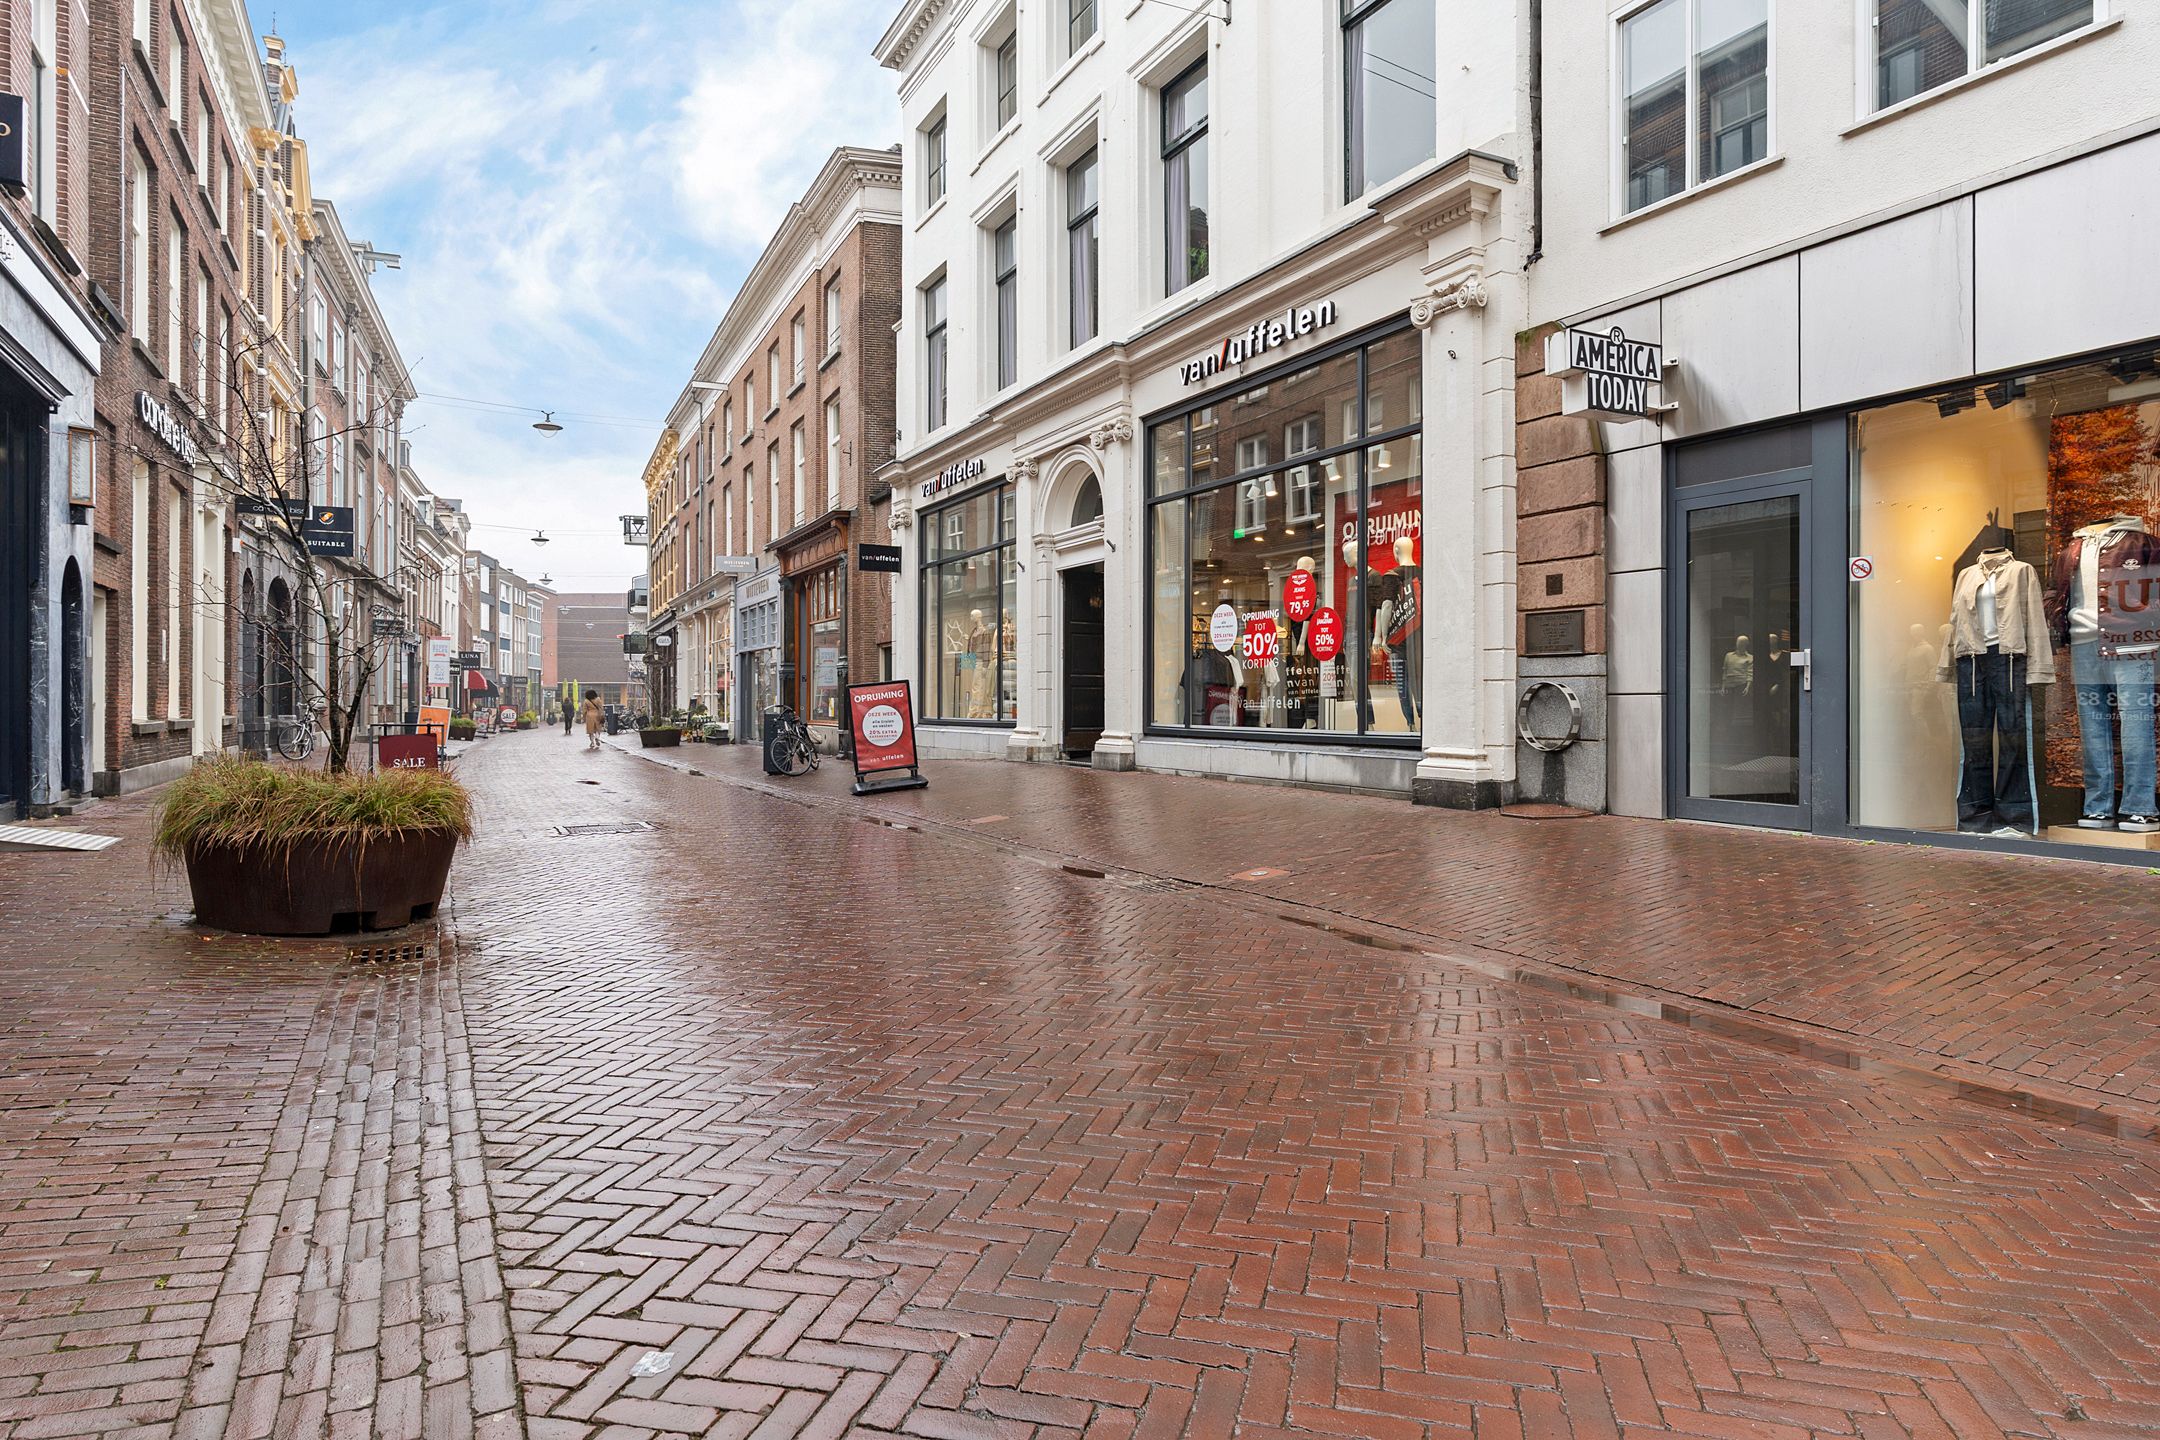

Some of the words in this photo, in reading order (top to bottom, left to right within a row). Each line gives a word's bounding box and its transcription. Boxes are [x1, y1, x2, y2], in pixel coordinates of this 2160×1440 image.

[1576, 336, 1658, 378] AMERICA
[1589, 373, 1645, 412] TODAY
[1241, 609, 1280, 622] OPRUIMING
[1254, 623, 1266, 631] TOT
[1242, 632, 1279, 657] 50%
[1315, 634, 1335, 646] 50%
[1242, 657, 1279, 670] KORTING
[854, 690, 904, 703] OPRUIMING
[502, 712, 516, 720] SALE
[393, 757, 426, 768] SALE
